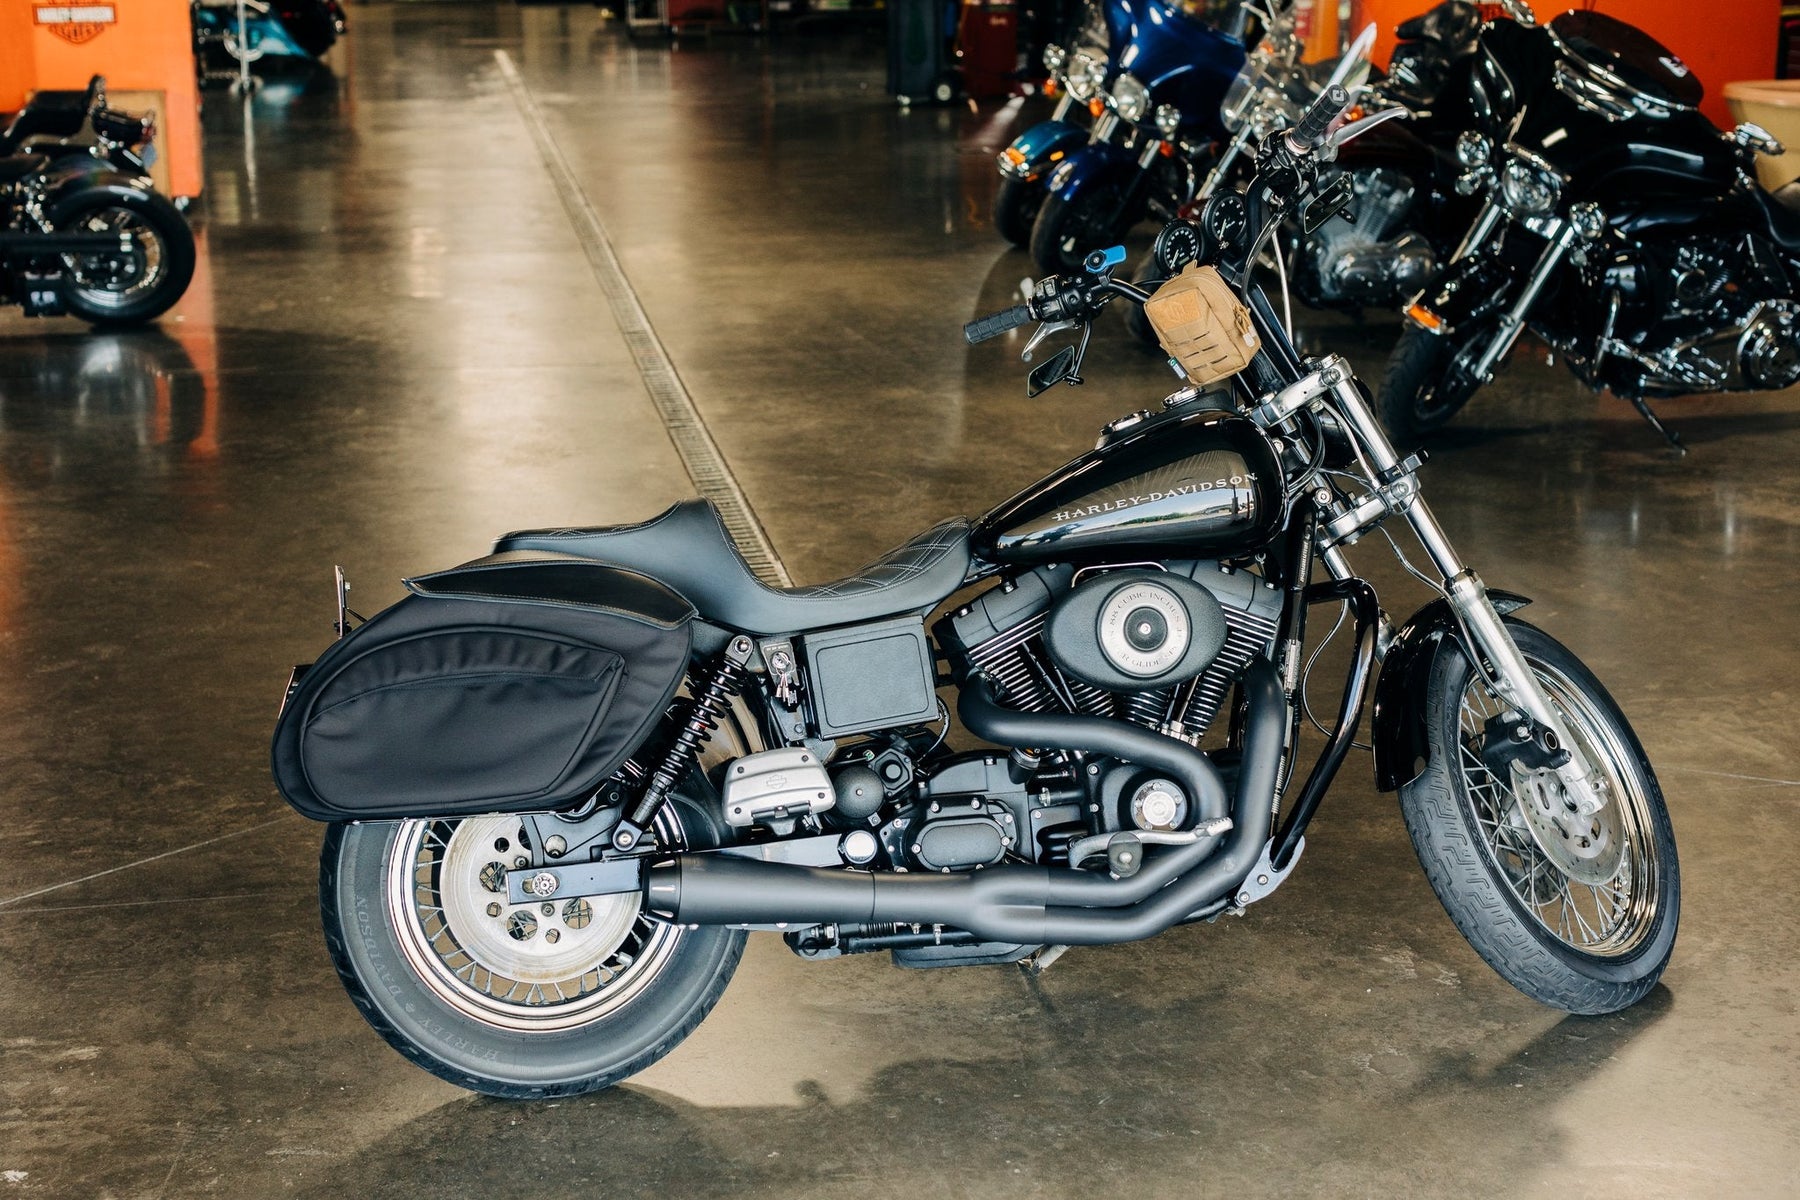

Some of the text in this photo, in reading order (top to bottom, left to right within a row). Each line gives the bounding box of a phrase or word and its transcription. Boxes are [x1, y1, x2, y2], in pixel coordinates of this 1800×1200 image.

[1052, 472, 1258, 522] HARLEY-DAVIDSON
[1118, 591, 1147, 610] CUBIC
[1149, 592, 1180, 623] INCHES
[356, 895, 498, 1061] HARLEY DAVIDSON
